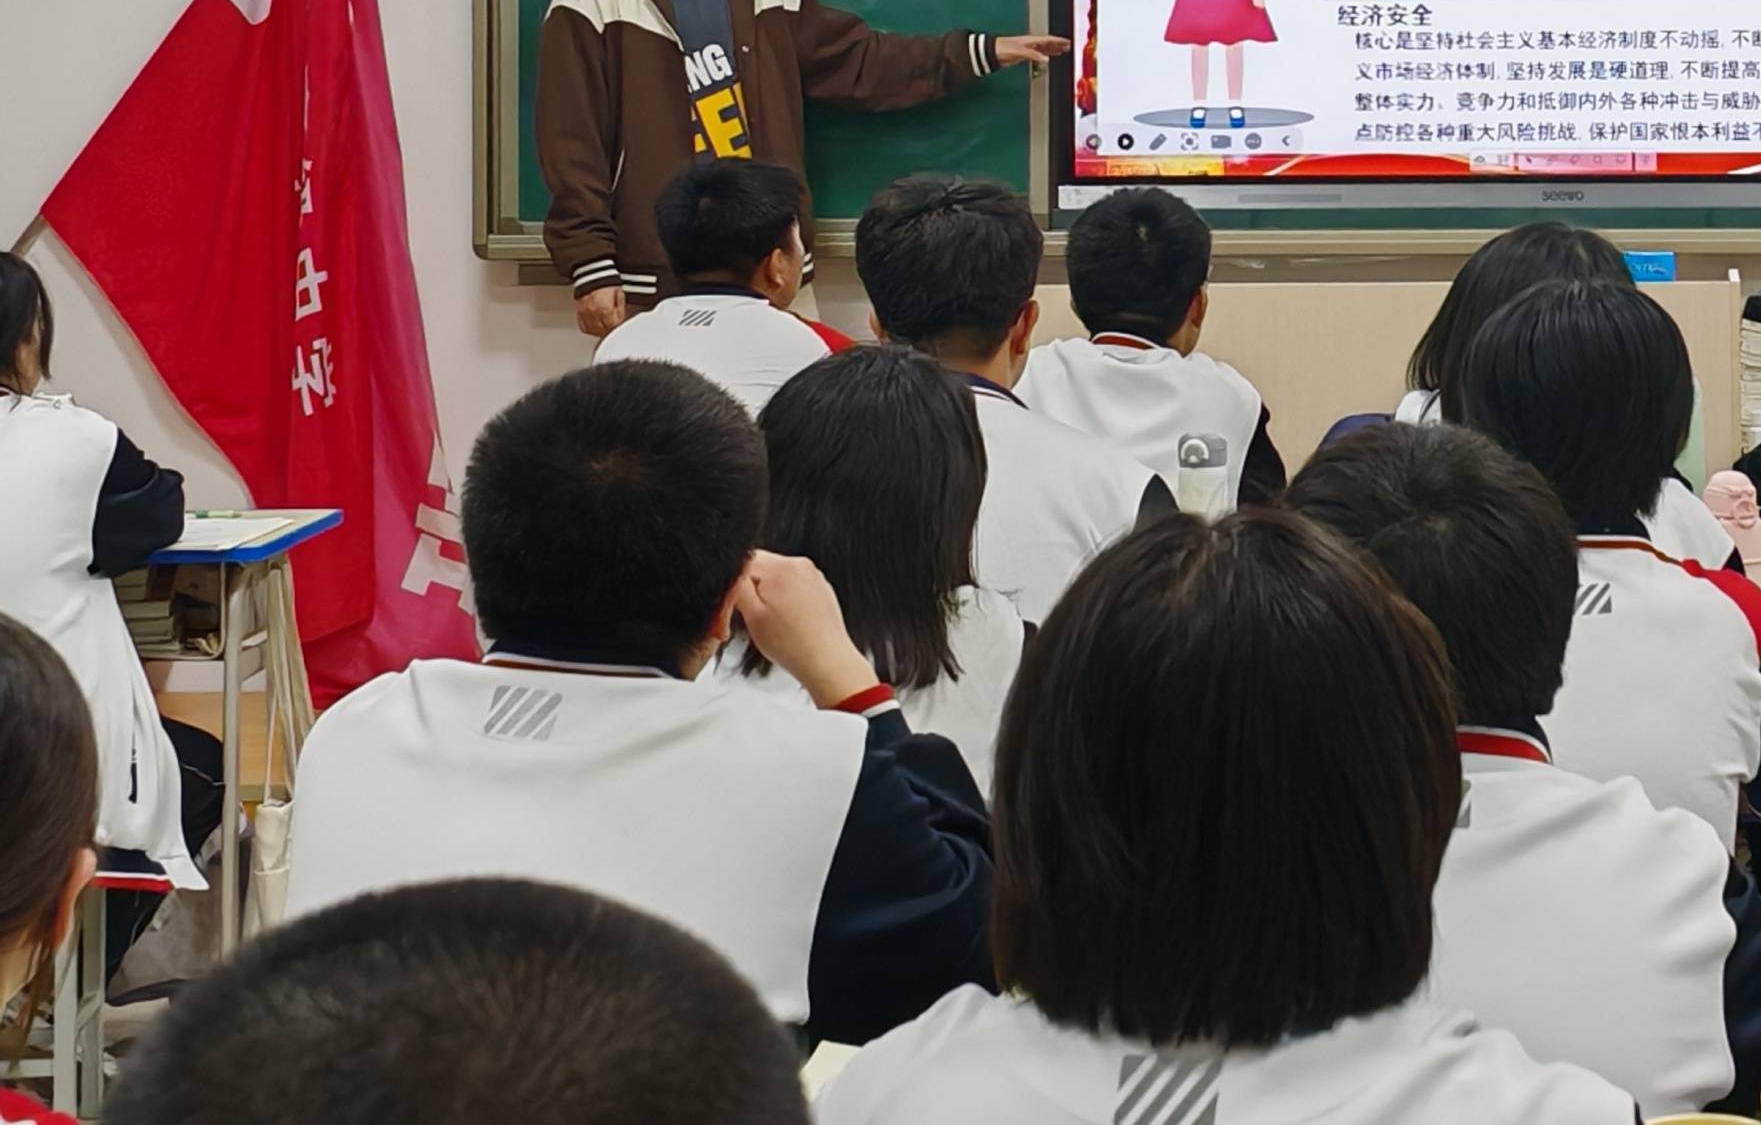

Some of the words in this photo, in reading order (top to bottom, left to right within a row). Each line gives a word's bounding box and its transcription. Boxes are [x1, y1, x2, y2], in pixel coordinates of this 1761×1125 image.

[1338, 4, 1433, 27] 经济安全
[684, 43, 733, 93] NG
[1541, 189, 1585, 202] seewo
